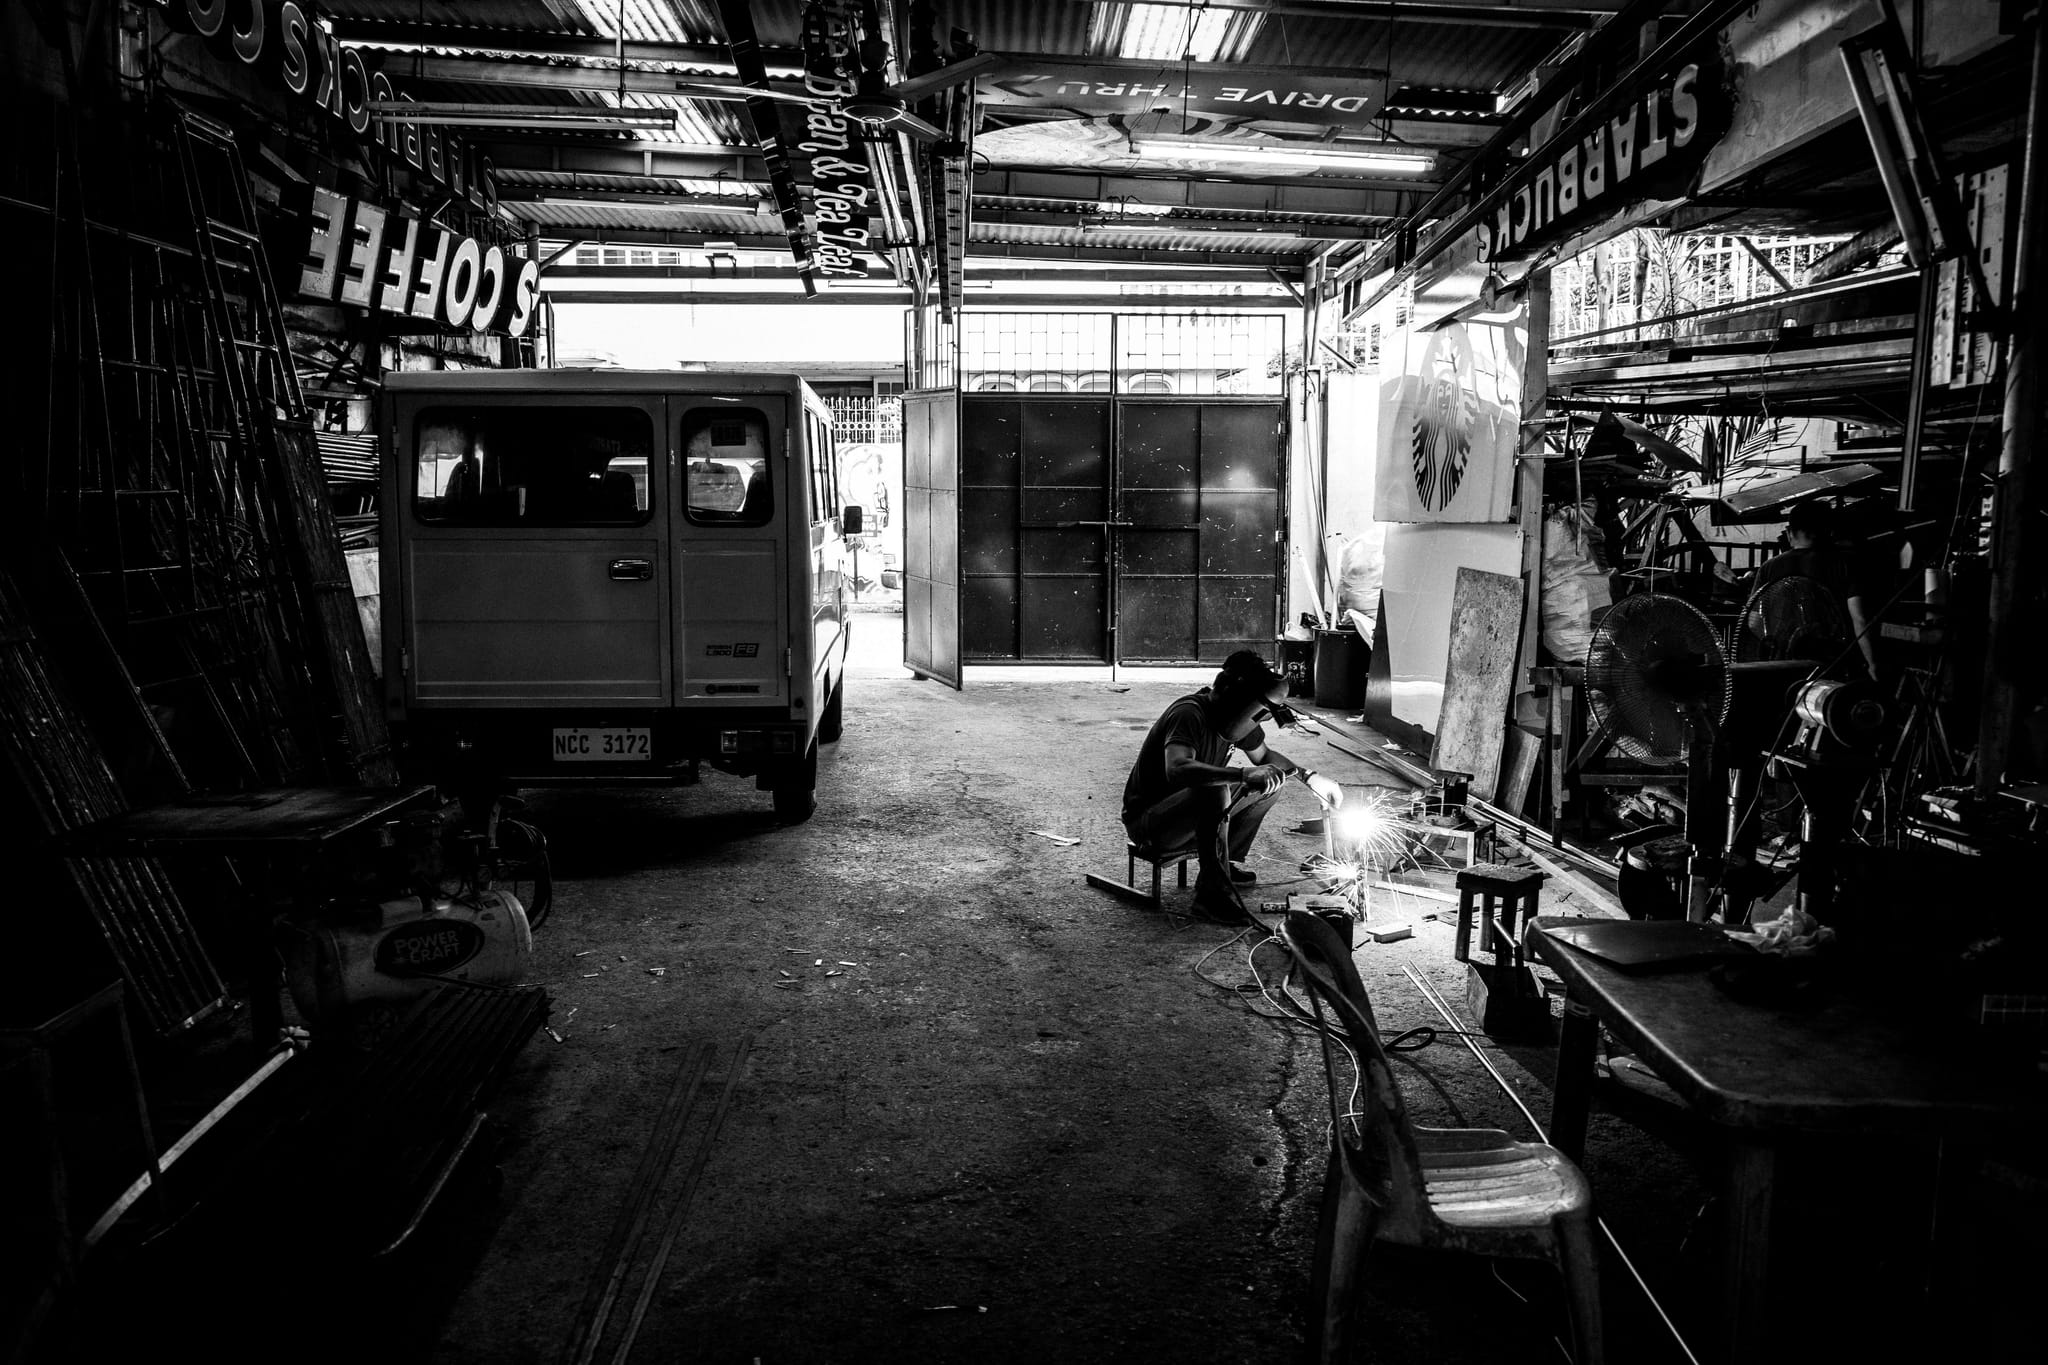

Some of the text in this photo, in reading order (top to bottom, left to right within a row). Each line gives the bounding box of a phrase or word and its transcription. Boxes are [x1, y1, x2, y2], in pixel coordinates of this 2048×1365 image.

[1056, 81, 1368, 112] DRIVE THRU
[811, 156, 870, 178] &
[1476, 63, 1700, 264] STARBUCKS
[813, 183, 868, 223] Tea
[300, 186, 504, 333] COFFEE
[817, 228, 869, 278] Leaf
[556, 735, 649, 754] NCC 3172
[393, 929, 459, 955] POWER
[409, 942, 461, 965] CRAFT
